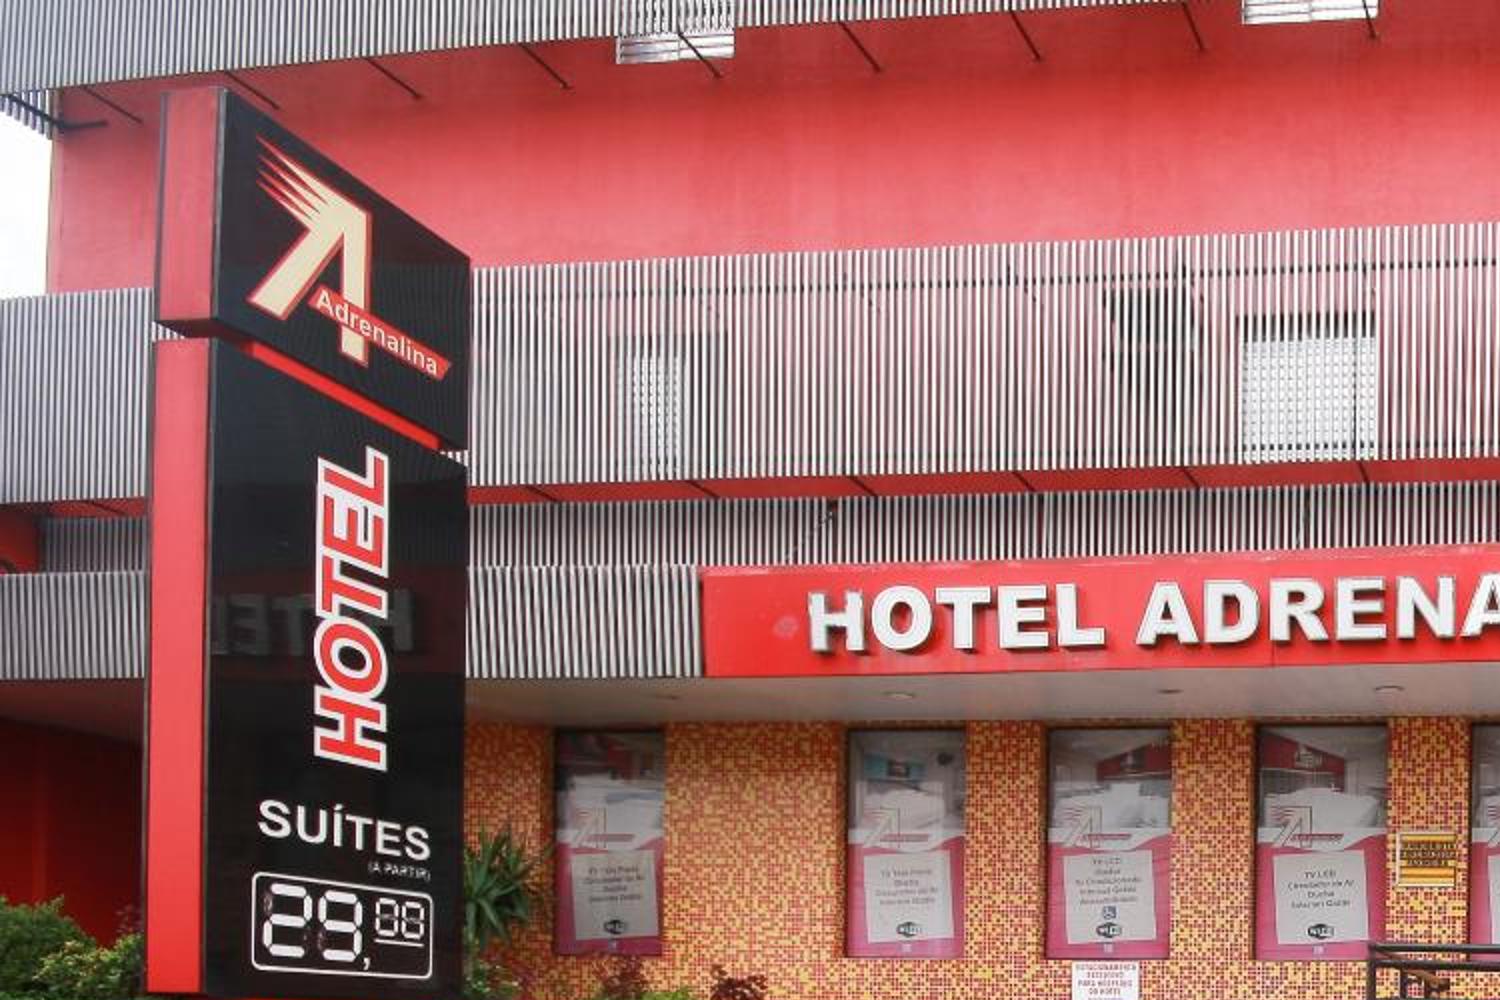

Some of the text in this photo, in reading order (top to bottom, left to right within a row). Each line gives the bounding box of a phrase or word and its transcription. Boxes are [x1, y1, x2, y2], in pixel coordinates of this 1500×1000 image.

[315, 288, 440, 376] Adrenalina
[313, 446, 390, 772] HOTEL
[807, 582, 1106, 653] HOTEL
[258, 799, 431, 861] SUÍTES
